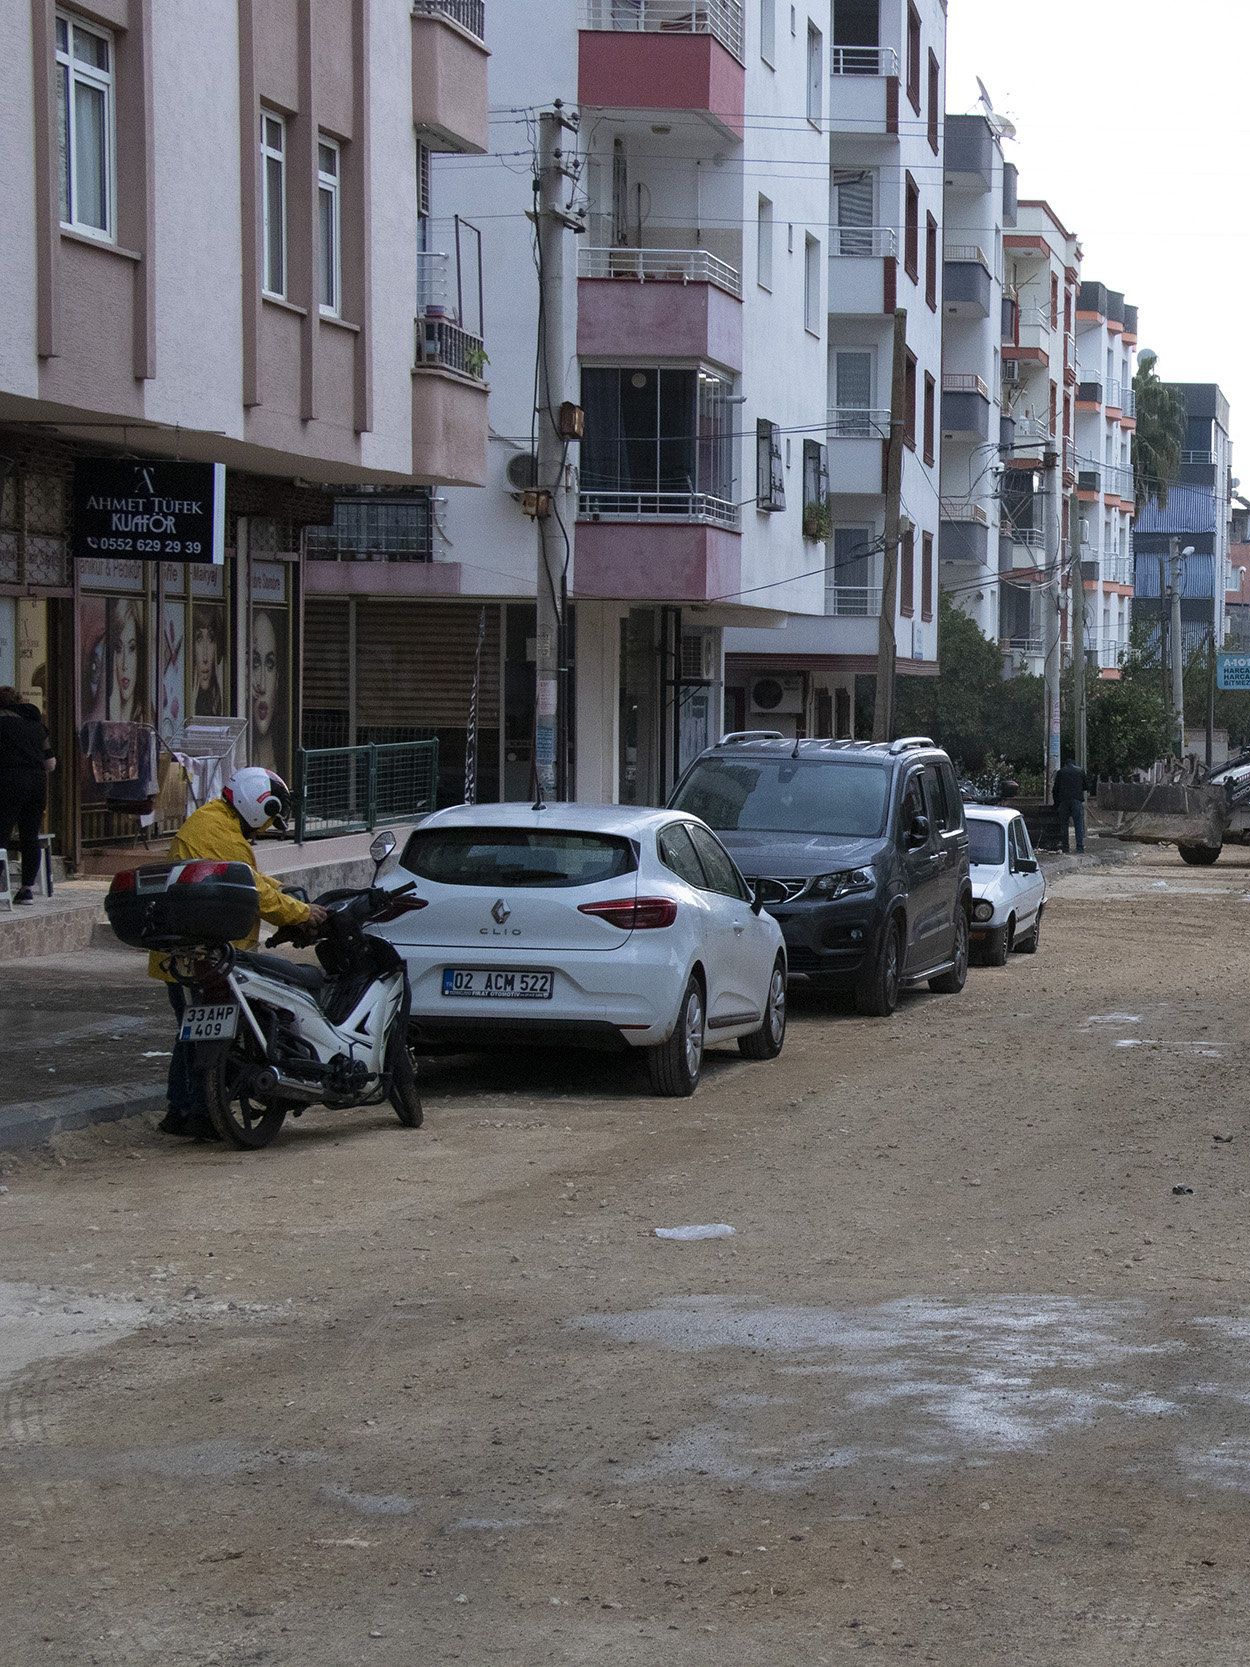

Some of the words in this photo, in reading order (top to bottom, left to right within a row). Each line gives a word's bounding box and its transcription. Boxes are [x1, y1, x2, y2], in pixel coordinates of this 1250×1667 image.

[86, 495, 147, 512] AHMET
[151, 497, 204, 515] TÜFEK
[111, 513, 177, 534] KUAFÖR
[100, 538, 133, 551] 0552
[137, 539, 161, 552] 629
[165, 541, 182, 553] 29
[185, 541, 202, 554] 39
[479, 928, 522, 936] CLIO
[455, 972, 473, 989] 02
[485, 973, 515, 991] ACM
[520, 974, 549, 992] 522
[187, 1009, 206, 1022] 33
[206, 1007, 234, 1021] AHP
[195, 1023, 222, 1037] 409
